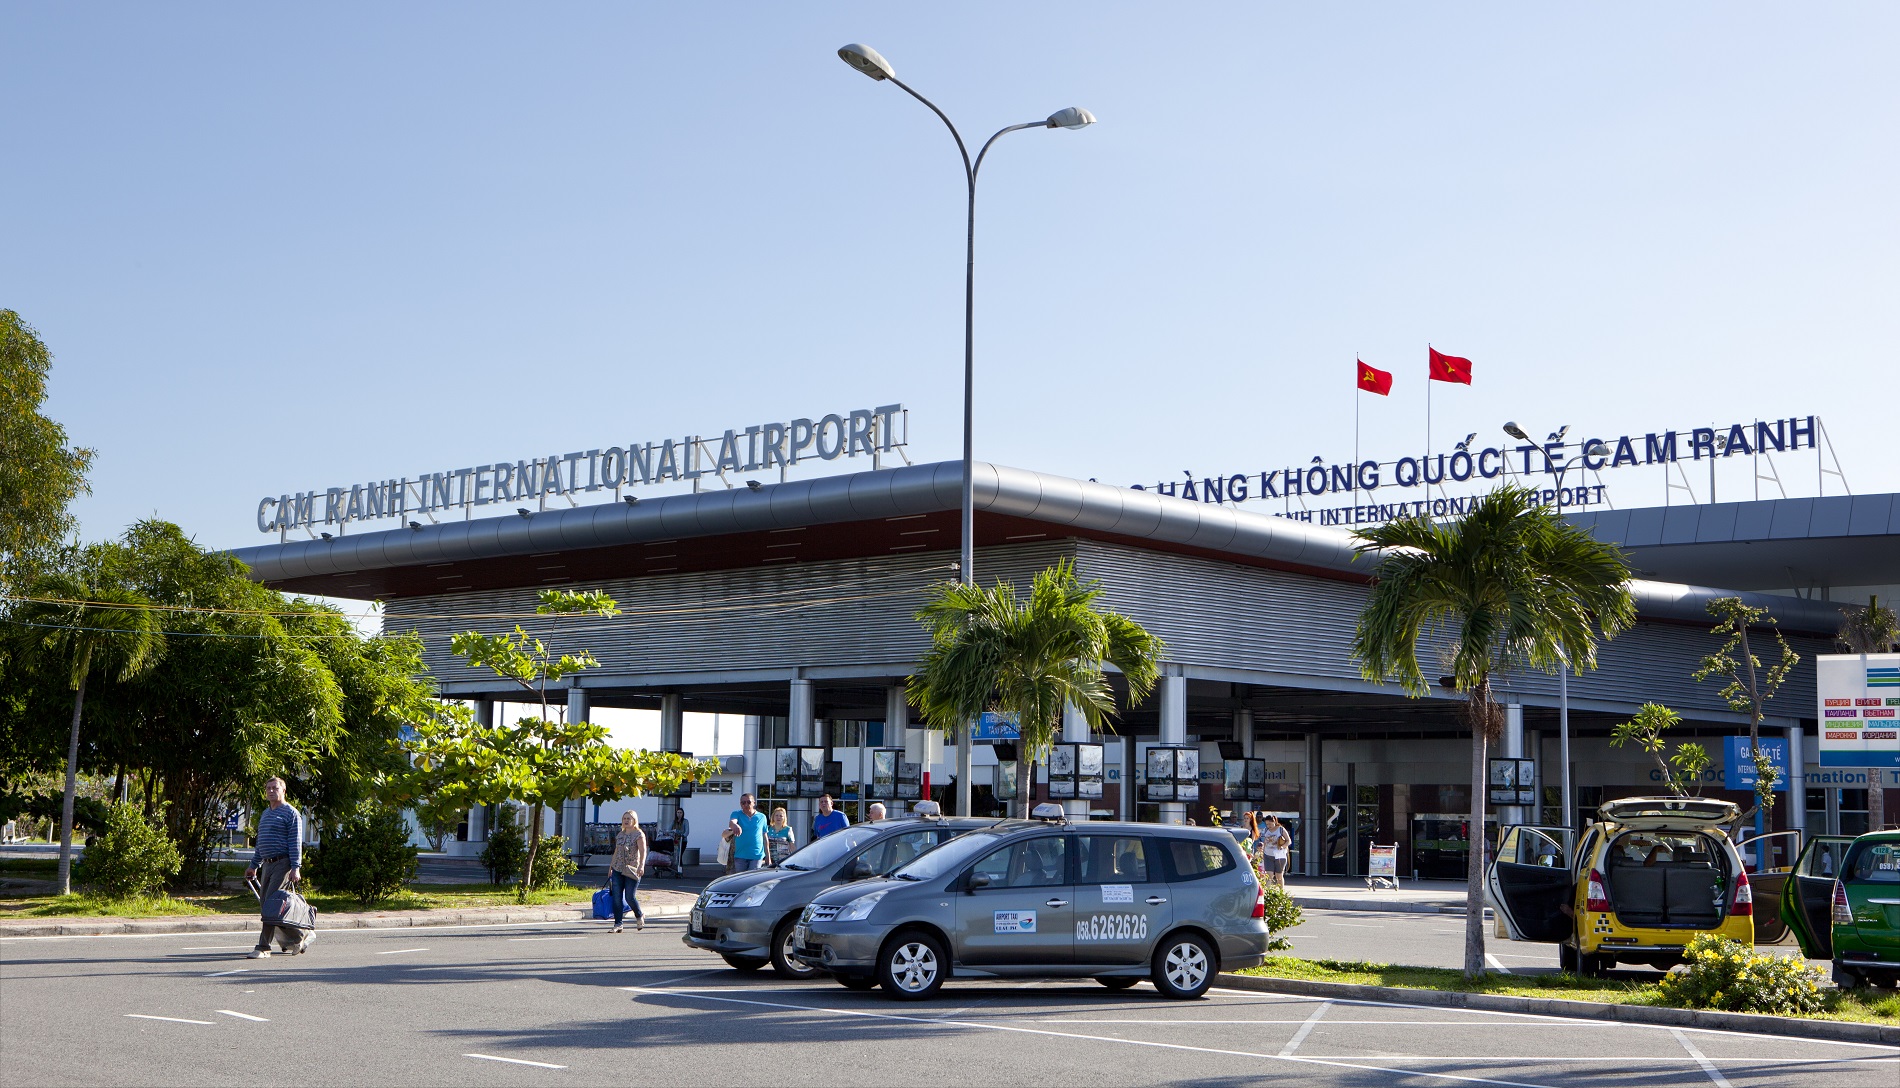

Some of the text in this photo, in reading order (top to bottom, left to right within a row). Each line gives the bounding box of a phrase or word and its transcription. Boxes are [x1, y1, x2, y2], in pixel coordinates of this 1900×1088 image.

[257, 403, 904, 533] CAM RANH INTERNATIONAL AIRPORT
[1260, 456, 1380, 499] KHÔNG
[1395, 432, 1501, 487] QUỐC
[1516, 425, 1570, 475] TẾ
[1583, 430, 1678, 471] CAM
[1692, 415, 1815, 461] RANH
[1741, 747, 1750, 758] GA
[1772, 744, 1781, 760] TẾ
[1076, 914, 1147, 940] 058.6262626
